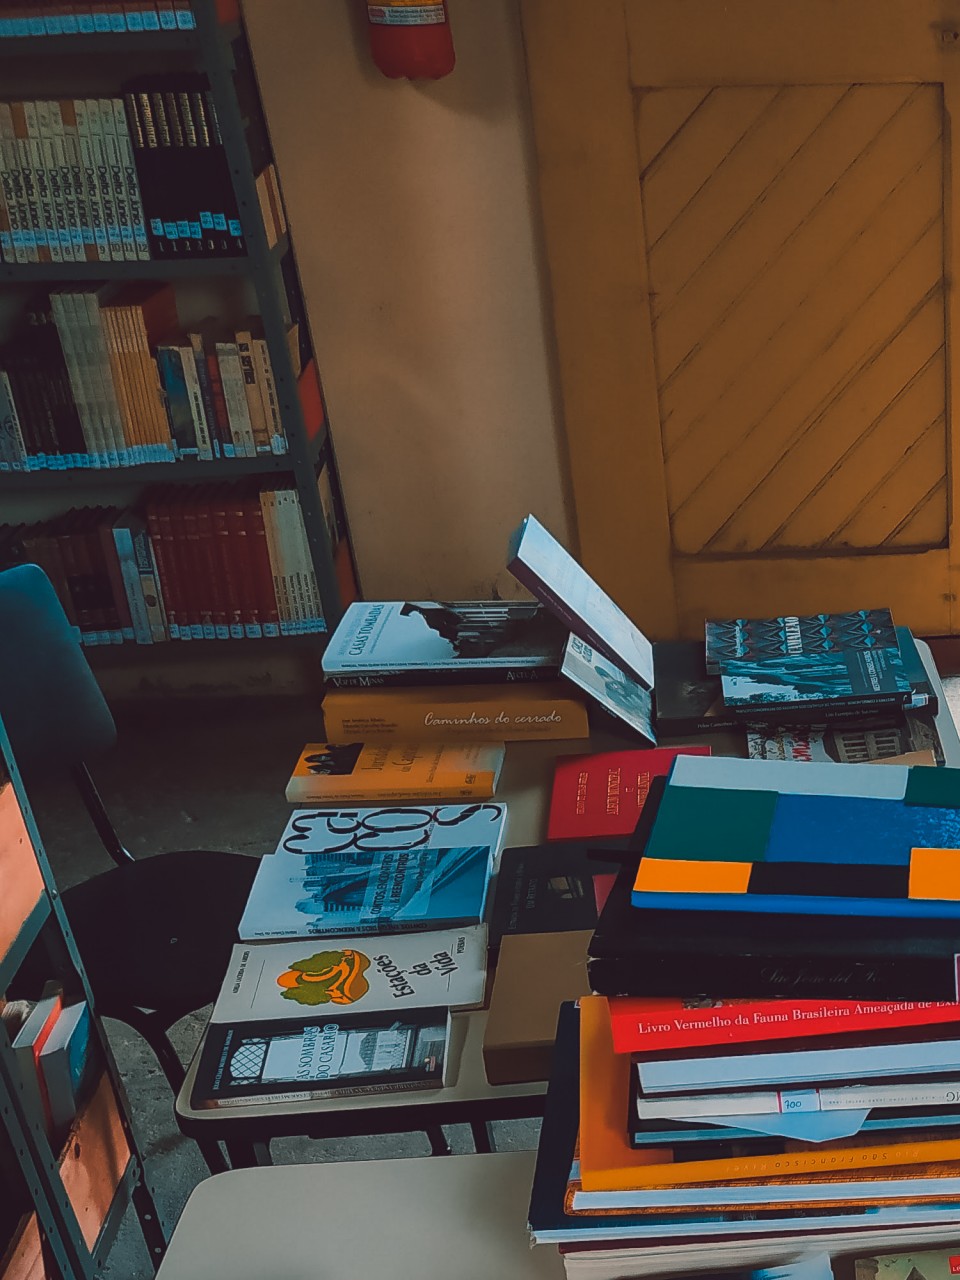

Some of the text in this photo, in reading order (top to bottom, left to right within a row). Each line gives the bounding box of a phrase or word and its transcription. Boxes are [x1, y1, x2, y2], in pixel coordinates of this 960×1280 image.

[60, 166, 72, 195] Delta
[112, 166, 123, 195] Delta
[348, 636, 368, 656] CASAS
[358, 604, 384, 635] TOMBADAS
[359, 676, 384, 687] MINAS
[424, 710, 562, 726] Caminhos do cerrado
[391, 853, 409, 898] REENCONTROS
[372, 954, 416, 998] Estações
[408, 963, 433, 977] da
[431, 951, 460, 977] Vida
[638, 1021, 671, 1035] Livro
[674, 1016, 731, 1033] Vermelho
[735, 1014, 750, 1026] da
[753, 1011, 788, 1025] Fauna
[792, 1006, 850, 1022] Brasileira
[854, 1002, 914, 1017] Ameaçada
[917, 1000, 932, 1010] de
[298, 1026, 321, 1068] SOMBRAS
[315, 1064, 331, 1080] DO
[784, 1100, 802, 1109] 700
[774, 1154, 854, 1168] Francisco
